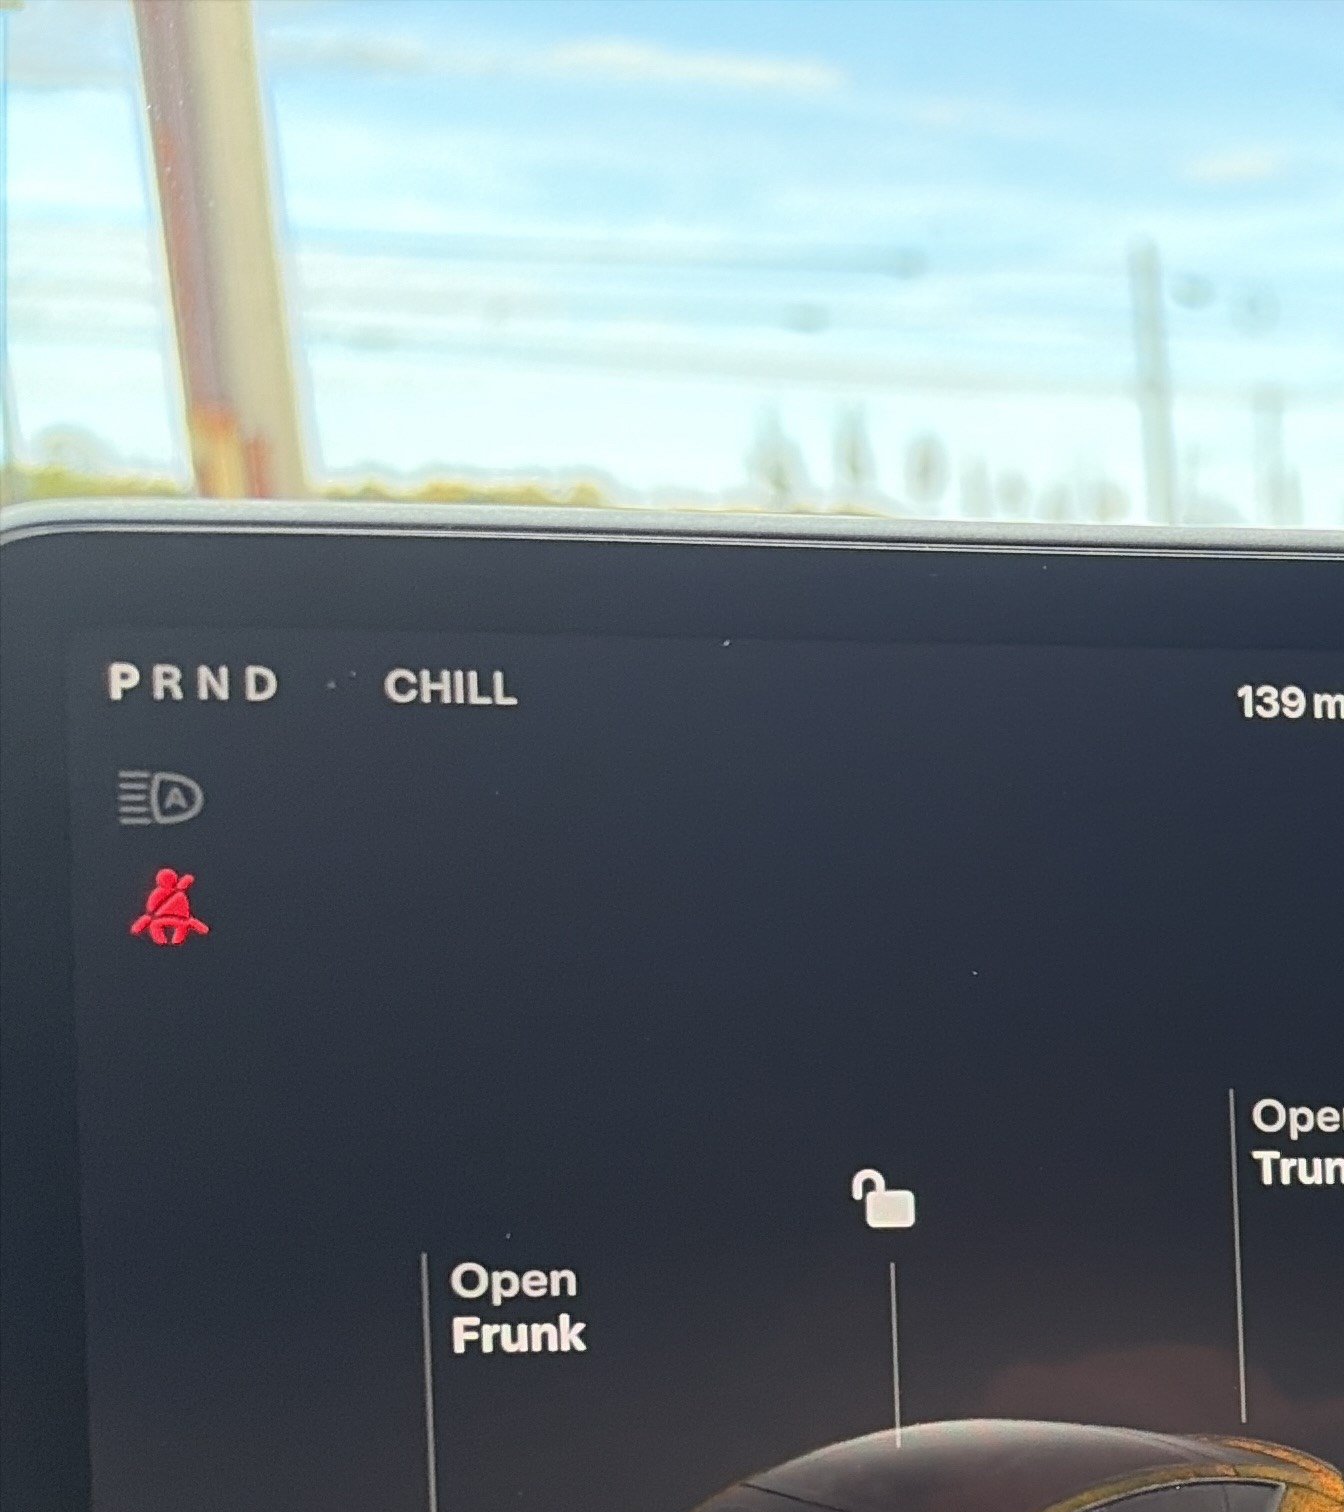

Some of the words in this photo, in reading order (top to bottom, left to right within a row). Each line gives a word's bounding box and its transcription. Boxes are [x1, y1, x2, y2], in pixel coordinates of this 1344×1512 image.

[384, 668, 518, 706] CHILL
[1237, 684, 1307, 719] 139
[450, 1262, 577, 1309] Open
[452, 1314, 587, 1356] Frunk
